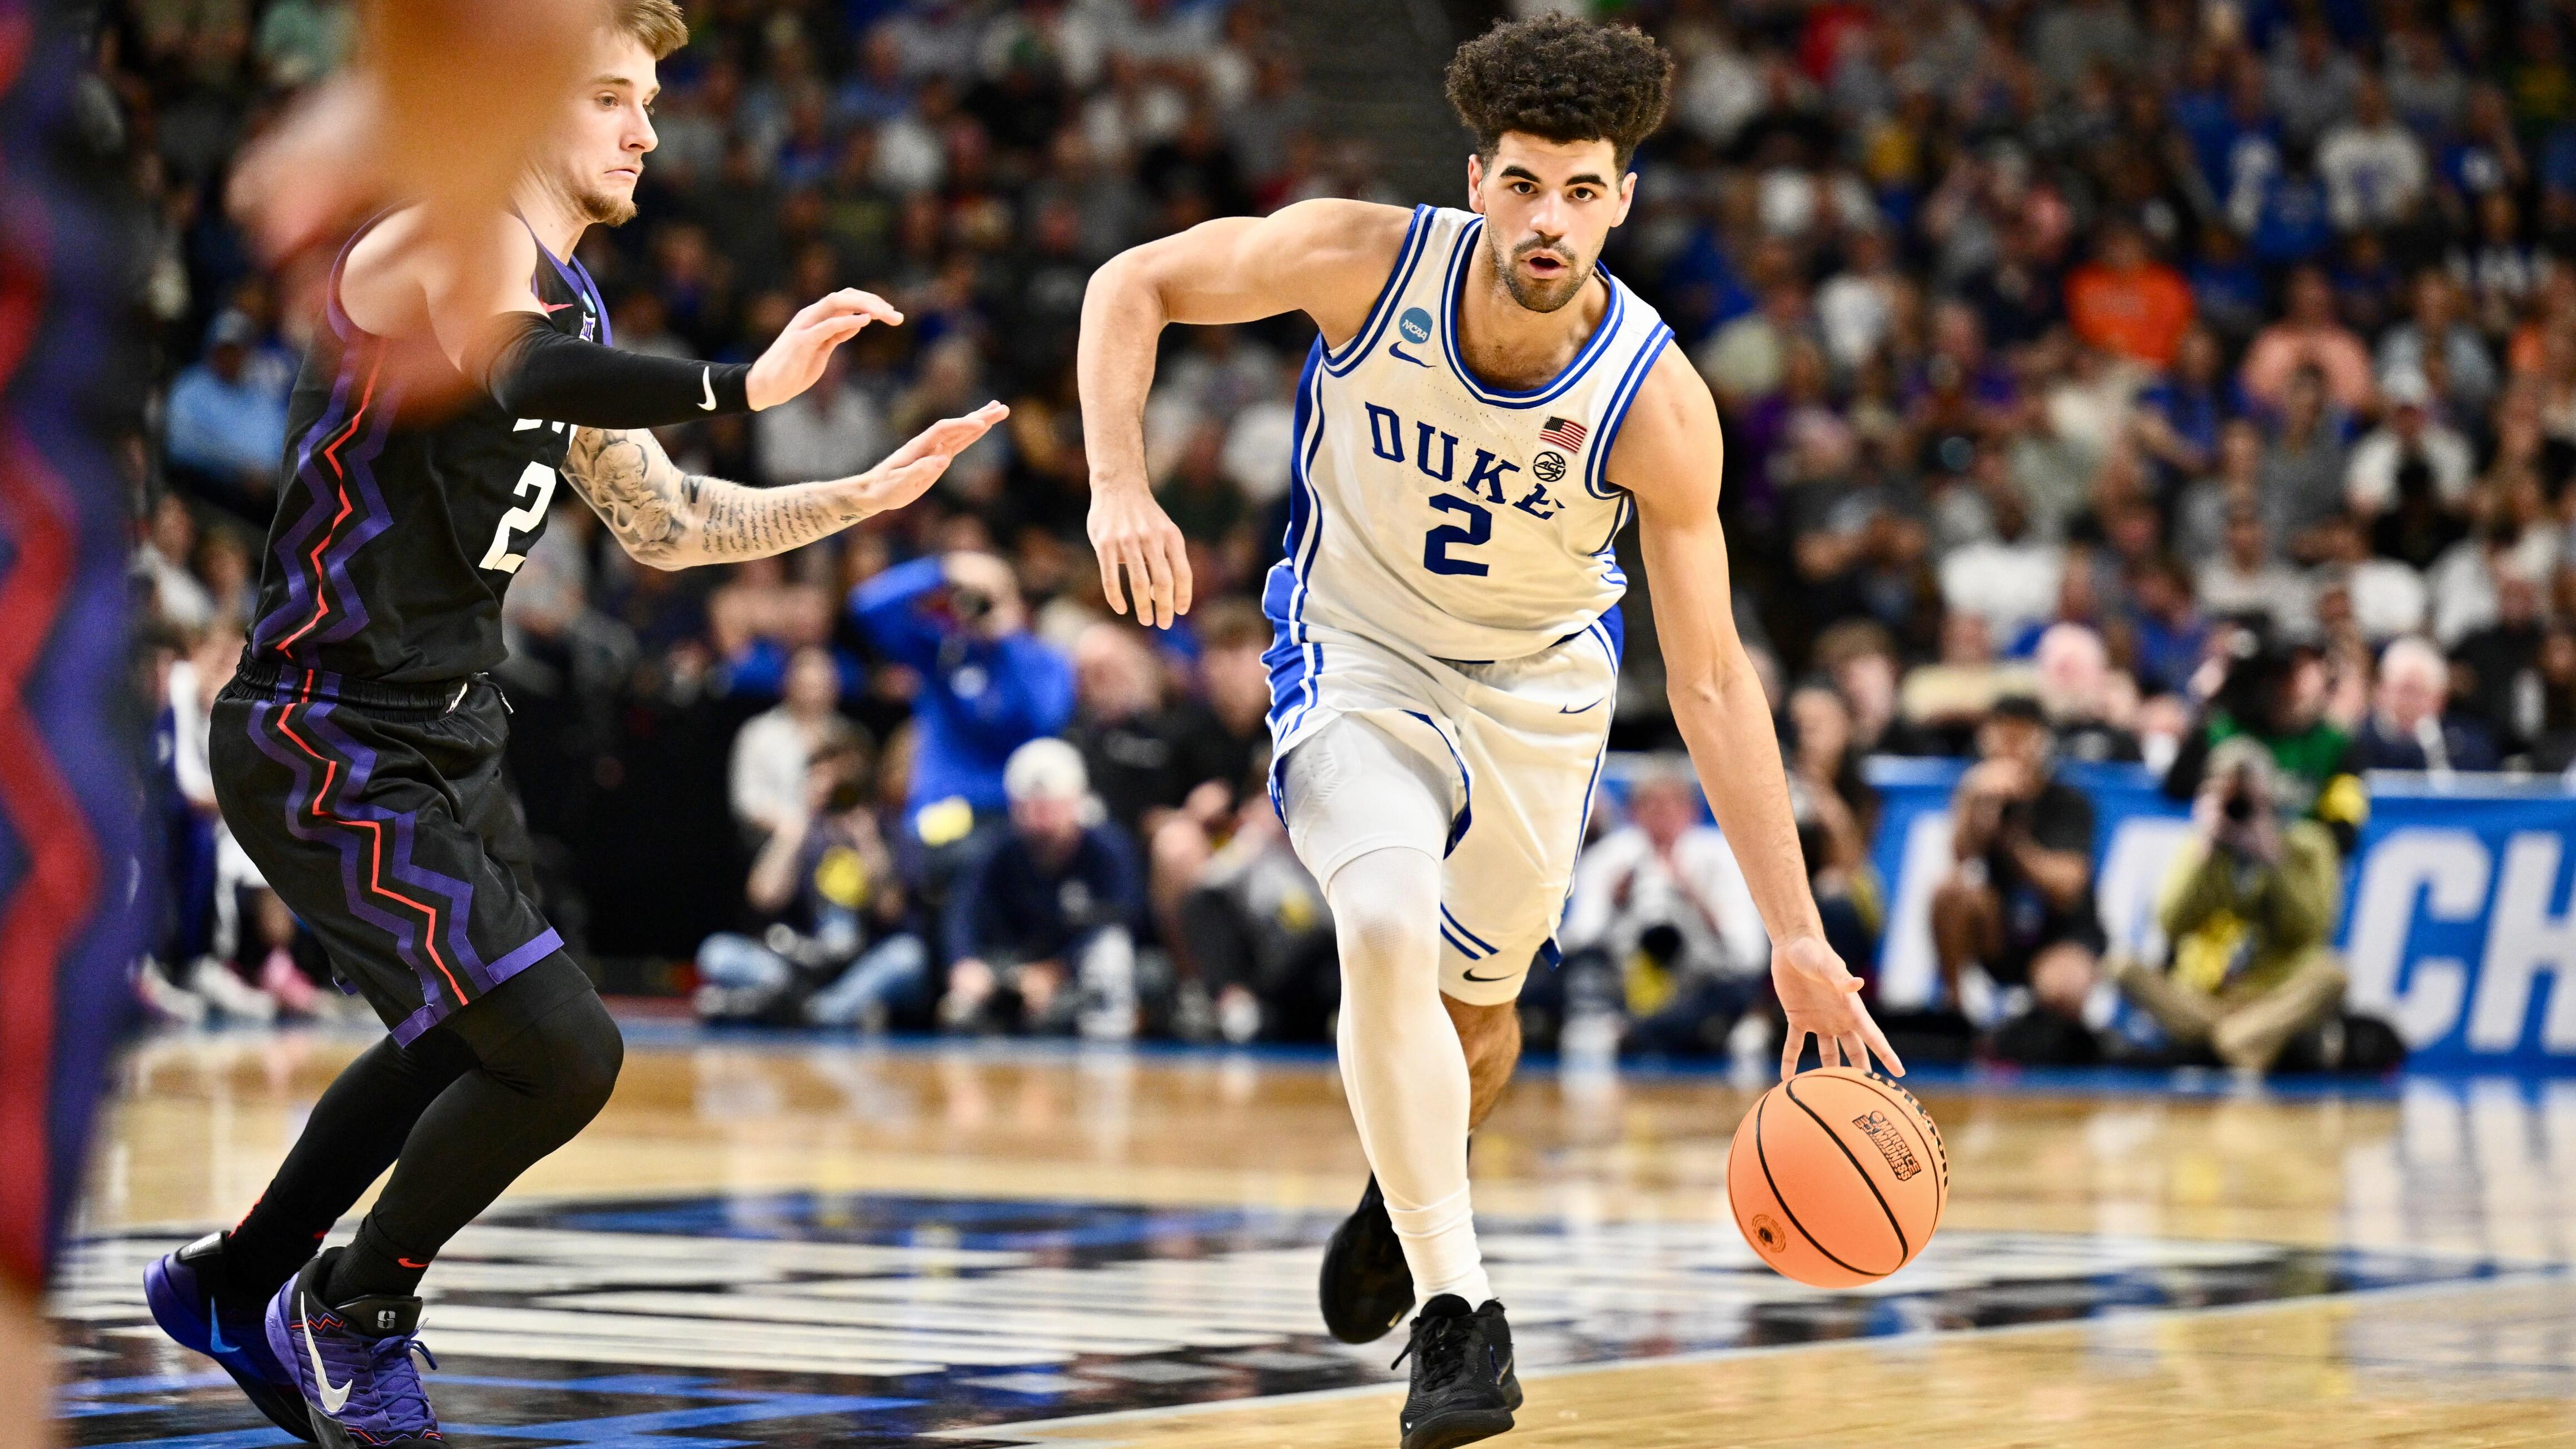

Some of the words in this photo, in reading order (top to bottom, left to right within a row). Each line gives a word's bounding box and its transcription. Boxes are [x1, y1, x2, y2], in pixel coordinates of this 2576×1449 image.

[1402, 319, 1428, 341] NCAA
[1365, 401, 1566, 520] DUKE
[1536, 461, 1565, 474] ACC
[479, 461, 556, 574] 2
[1424, 493, 1492, 577] 2
[1873, 1129, 1912, 1180] MADNESS
[1878, 1119, 1912, 1157] MARCH
